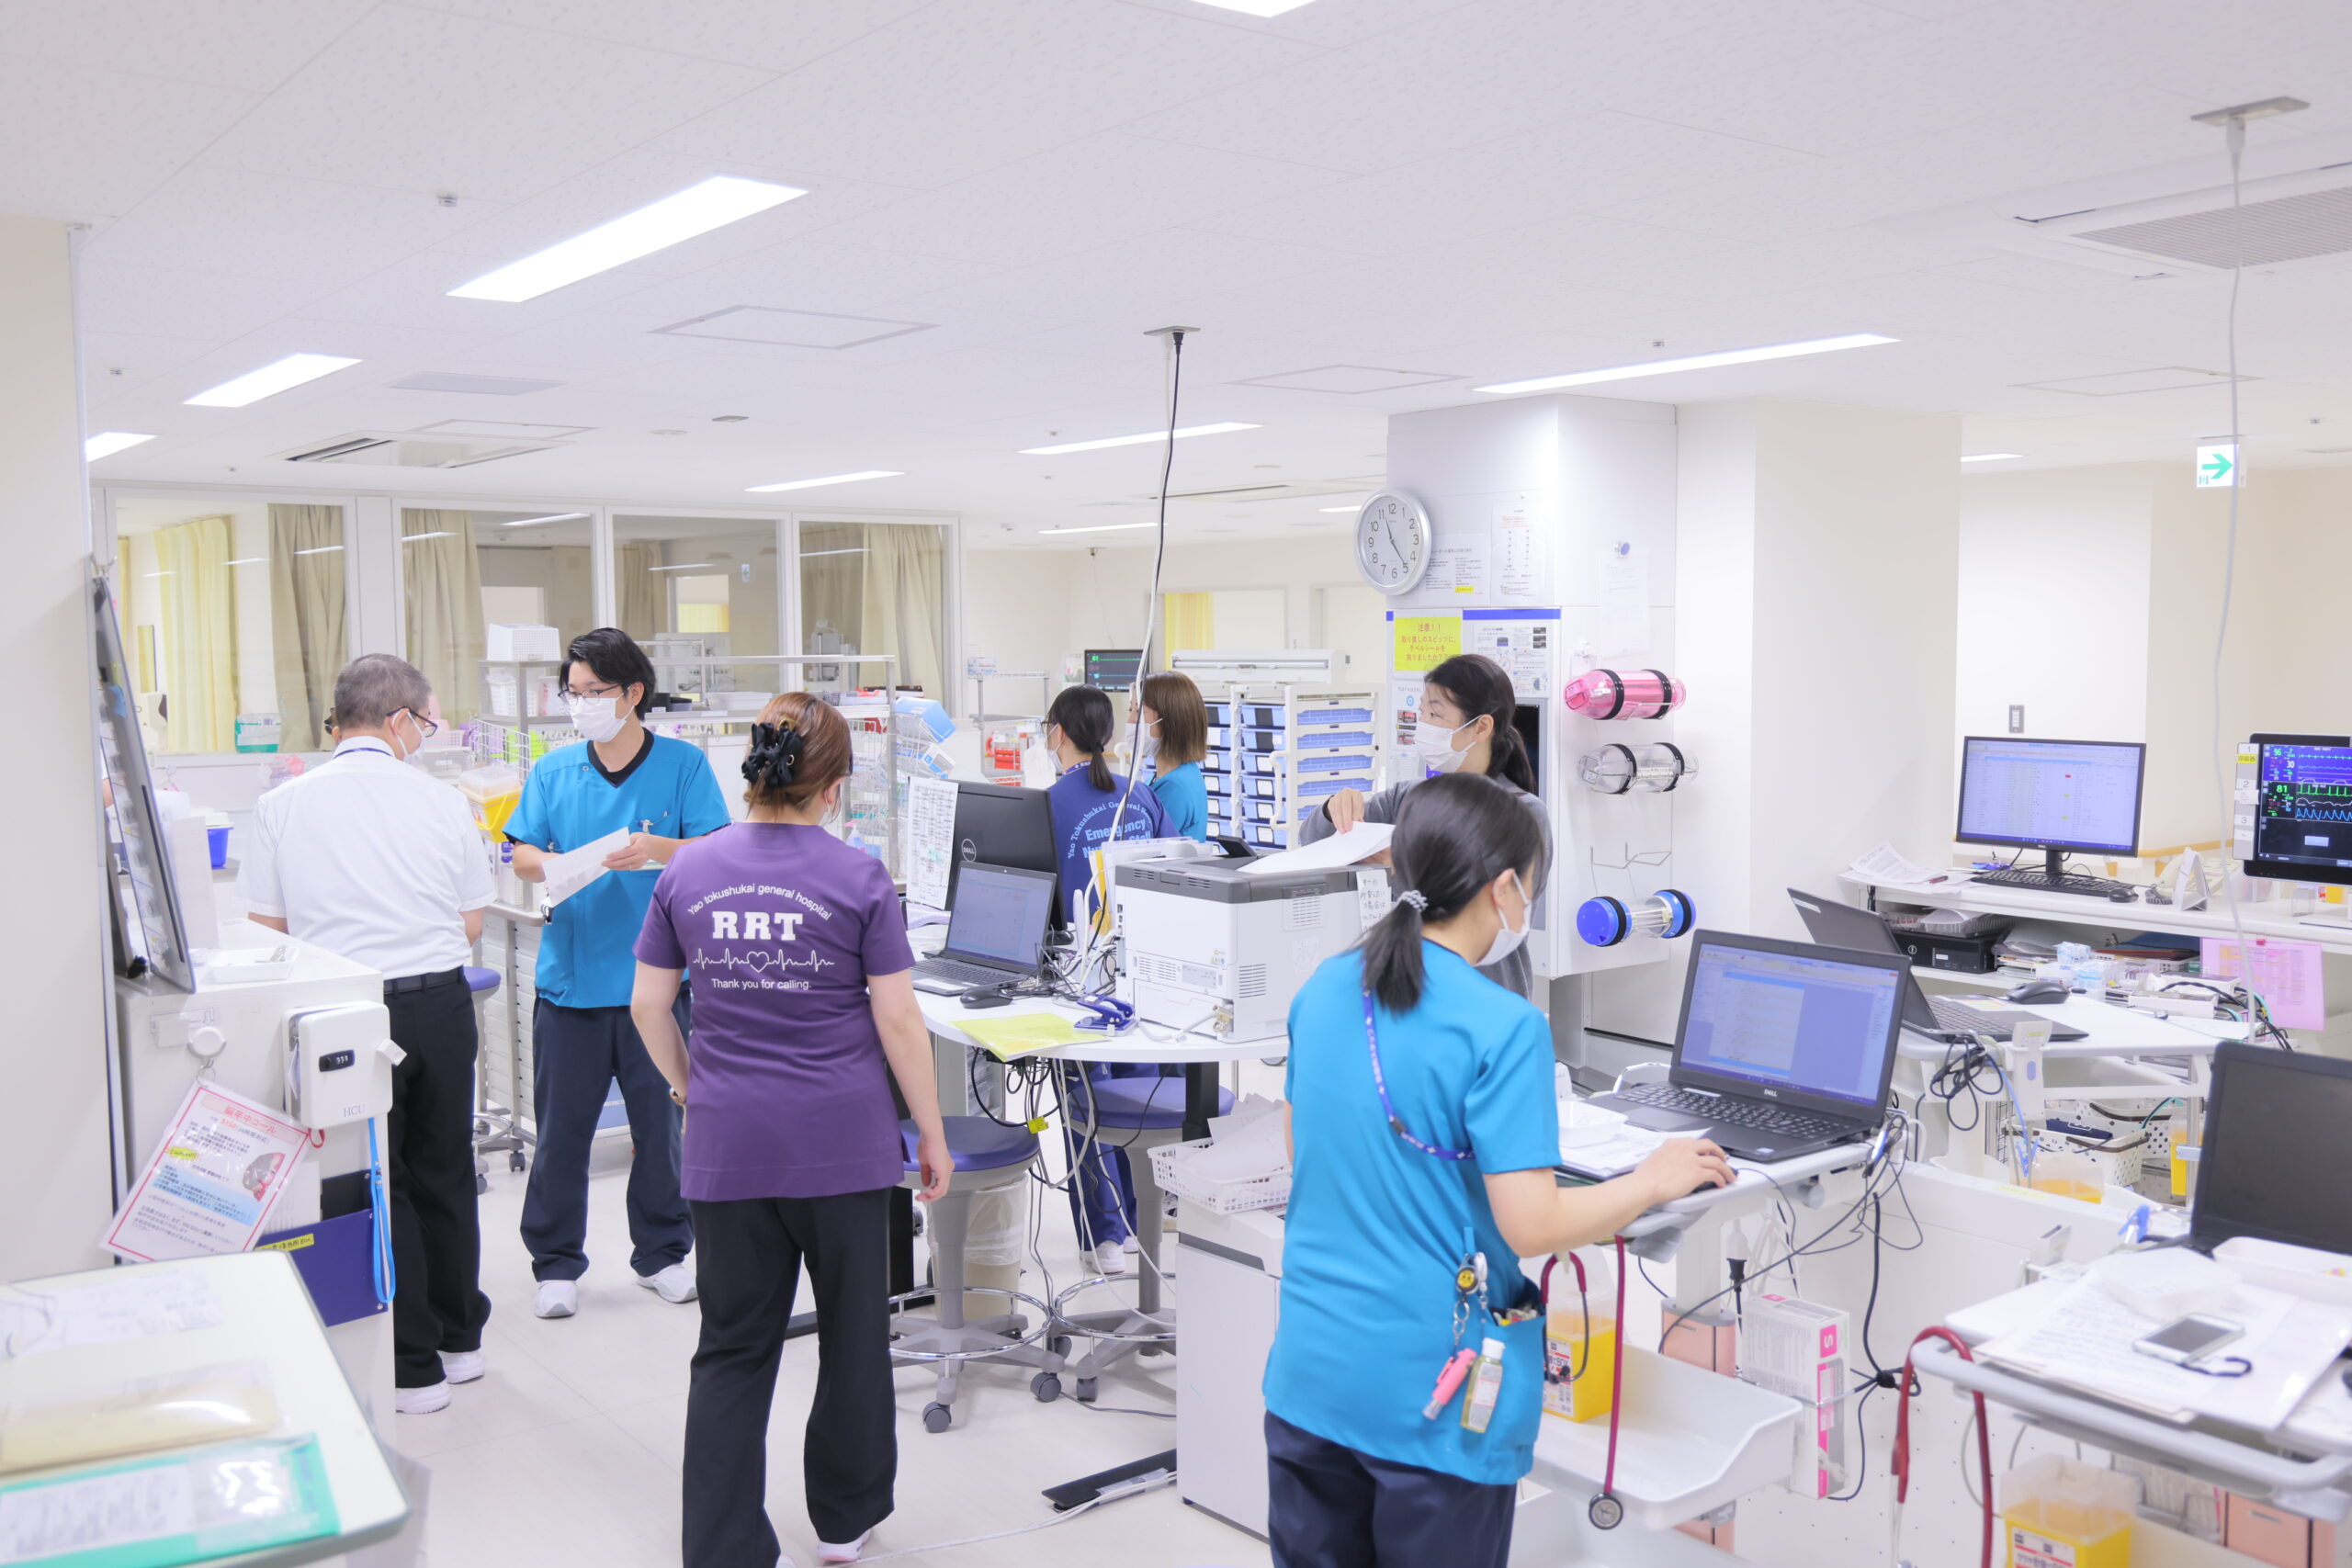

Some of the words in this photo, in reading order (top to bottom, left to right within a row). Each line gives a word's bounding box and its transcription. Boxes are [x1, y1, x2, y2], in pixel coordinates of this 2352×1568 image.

[1379, 509, 1384, 519] 11
[1389, 503, 1396, 514] 12
[1402, 507, 1405, 517] 1
[1371, 521, 1379, 532] 10
[1409, 519, 1415, 529] 2
[1368, 537, 1374, 548] 9
[1413, 534, 1419, 545] 3
[1372, 553, 1378, 563] 8
[1410, 551, 1416, 561] 4
[1381, 564, 1386, 575] 7
[1391, 568, 1397, 578] 6
[1403, 563, 1408, 573] 5
[2276, 784, 2288, 793] 81
[1108, 801, 1140, 811] Geeral
[687, 901, 704, 915] Yao
[704, 883, 755, 905] tokushukai
[758, 885, 795, 899] general
[795, 892, 832, 921] hospital
[712, 911, 803, 941] RRT
[711, 978, 740, 988] Thank
[742, 980, 758, 990] you
[761, 979, 775, 989] for
[778, 979, 812, 990] calling.
[343, 1103, 366, 1117] HCU
[1824, 1334, 1834, 1348] S
